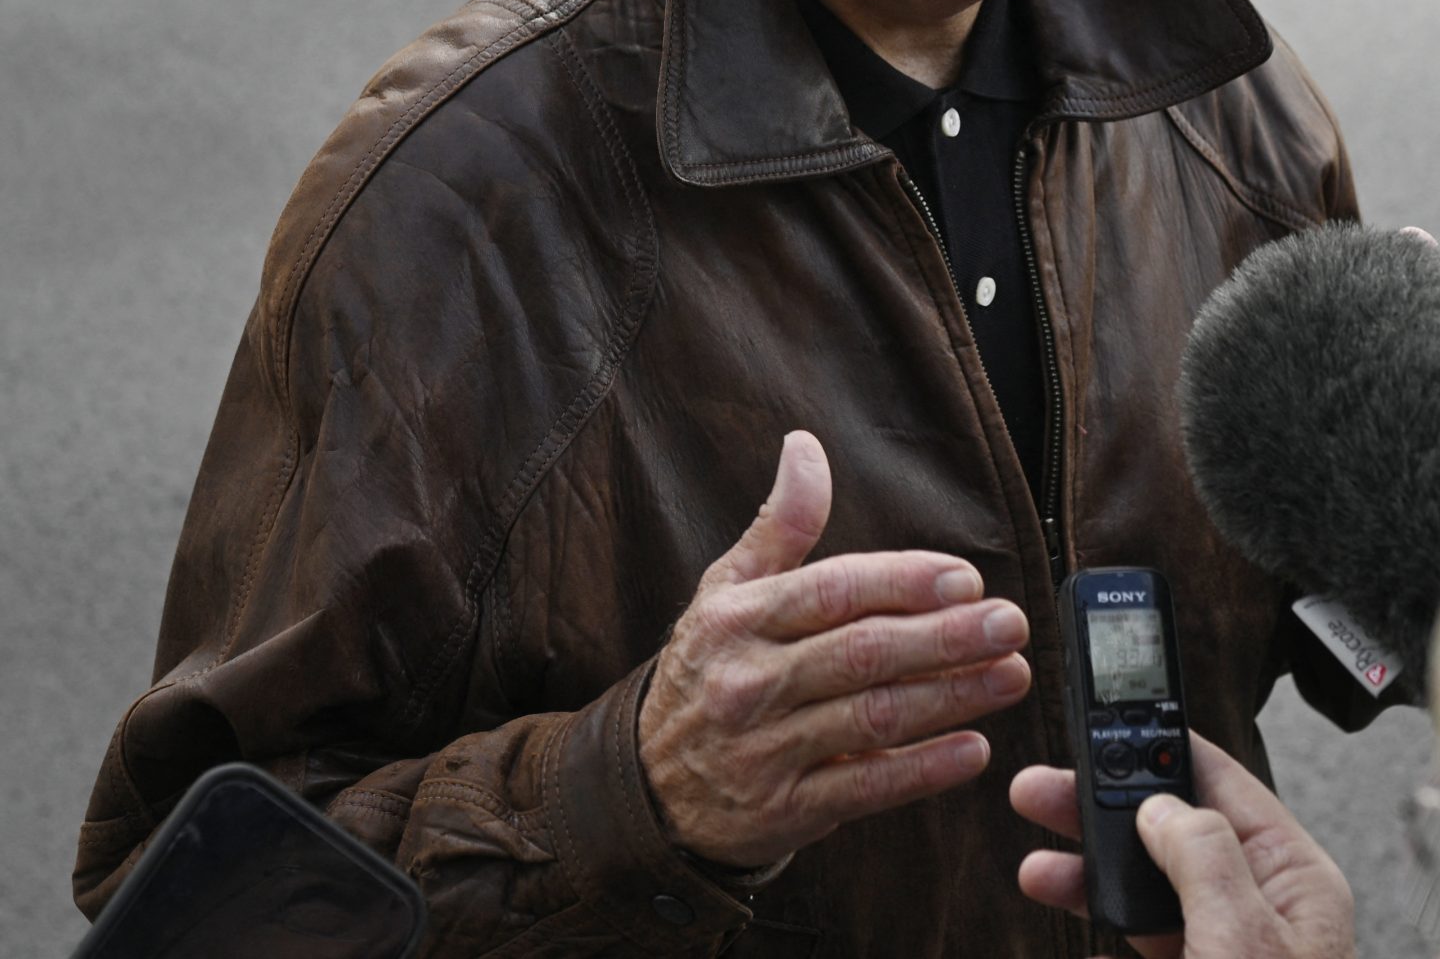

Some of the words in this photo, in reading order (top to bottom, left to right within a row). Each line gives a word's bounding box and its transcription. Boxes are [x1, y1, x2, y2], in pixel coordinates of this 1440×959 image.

[1097, 591, 1146, 603] SONY
[1328, 619, 1375, 672] Rycote
[1140, 728, 1181, 738] REC/PAUSE
